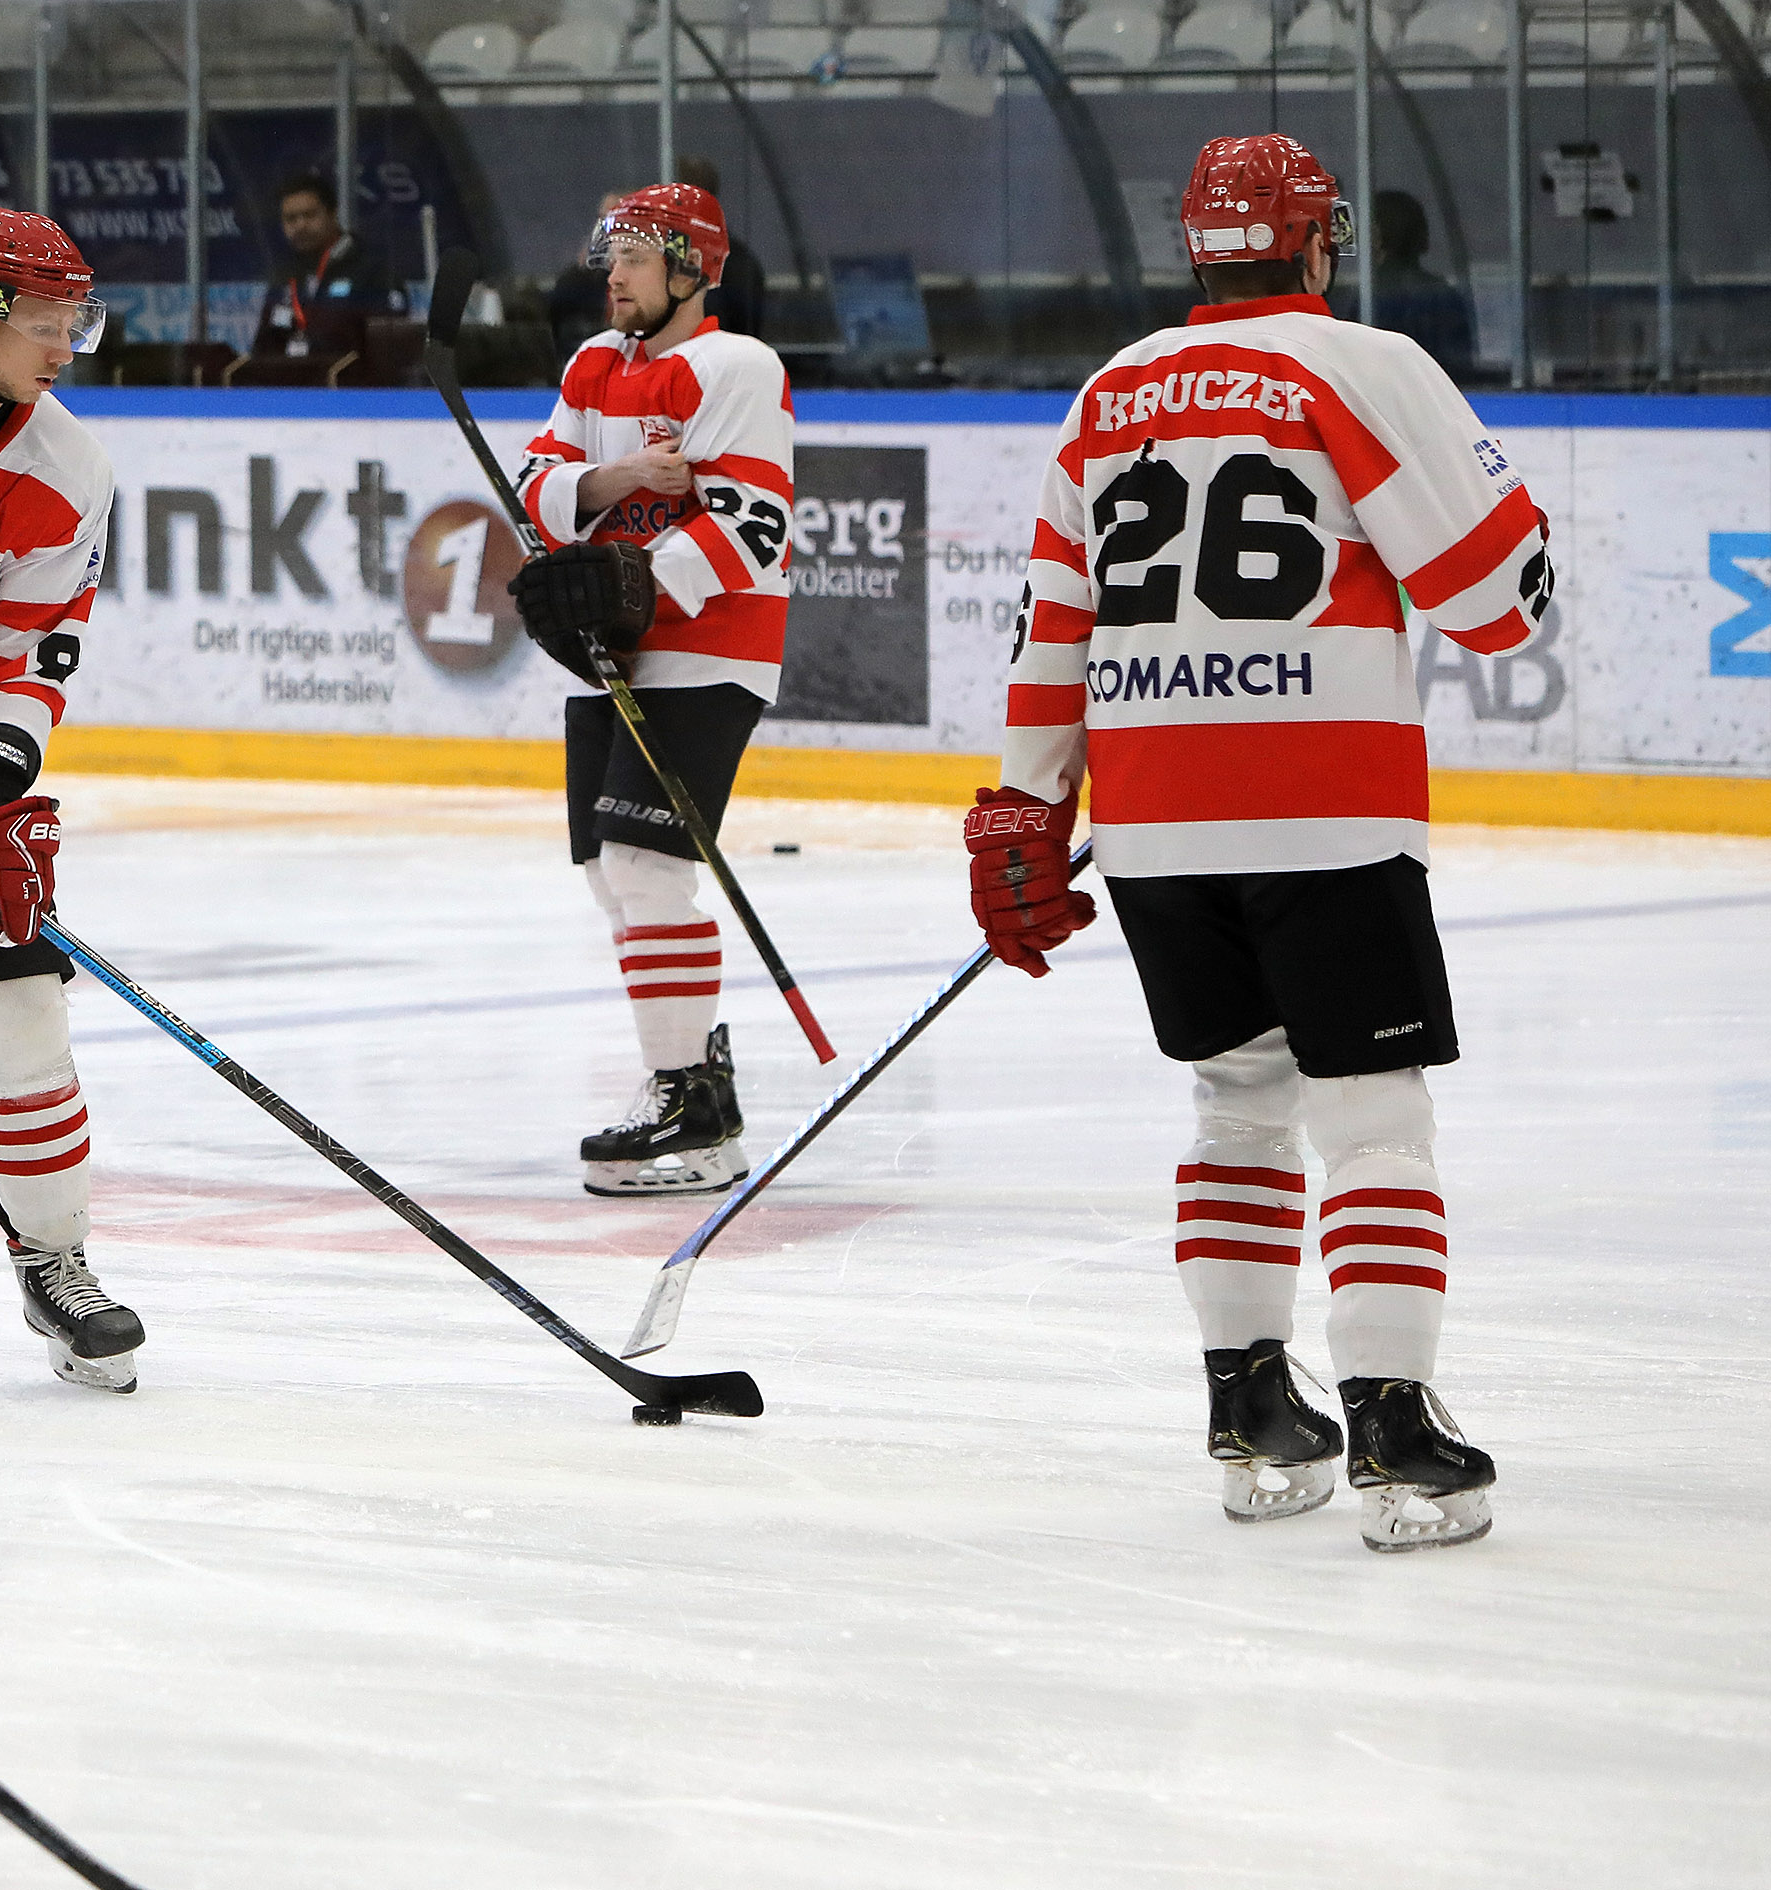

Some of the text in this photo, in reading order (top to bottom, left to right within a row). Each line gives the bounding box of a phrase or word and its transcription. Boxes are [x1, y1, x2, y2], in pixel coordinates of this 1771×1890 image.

[65, 272, 91, 282] BAUER
[1095, 370, 1316, 431] KRUCZEK
[1496, 476, 1523, 498] Krakó
[1093, 453, 1326, 625] 26
[946, 541, 985, 573] Du
[946, 597, 982, 624] en
[195, 620, 396, 664] Det rigtige valg
[263, 671, 395, 704] Haderslev
[1087, 652, 1312, 702] COMARCH
[126, 980, 195, 1036] NEXUS
[1374, 1020, 1423, 1040] BAUER
